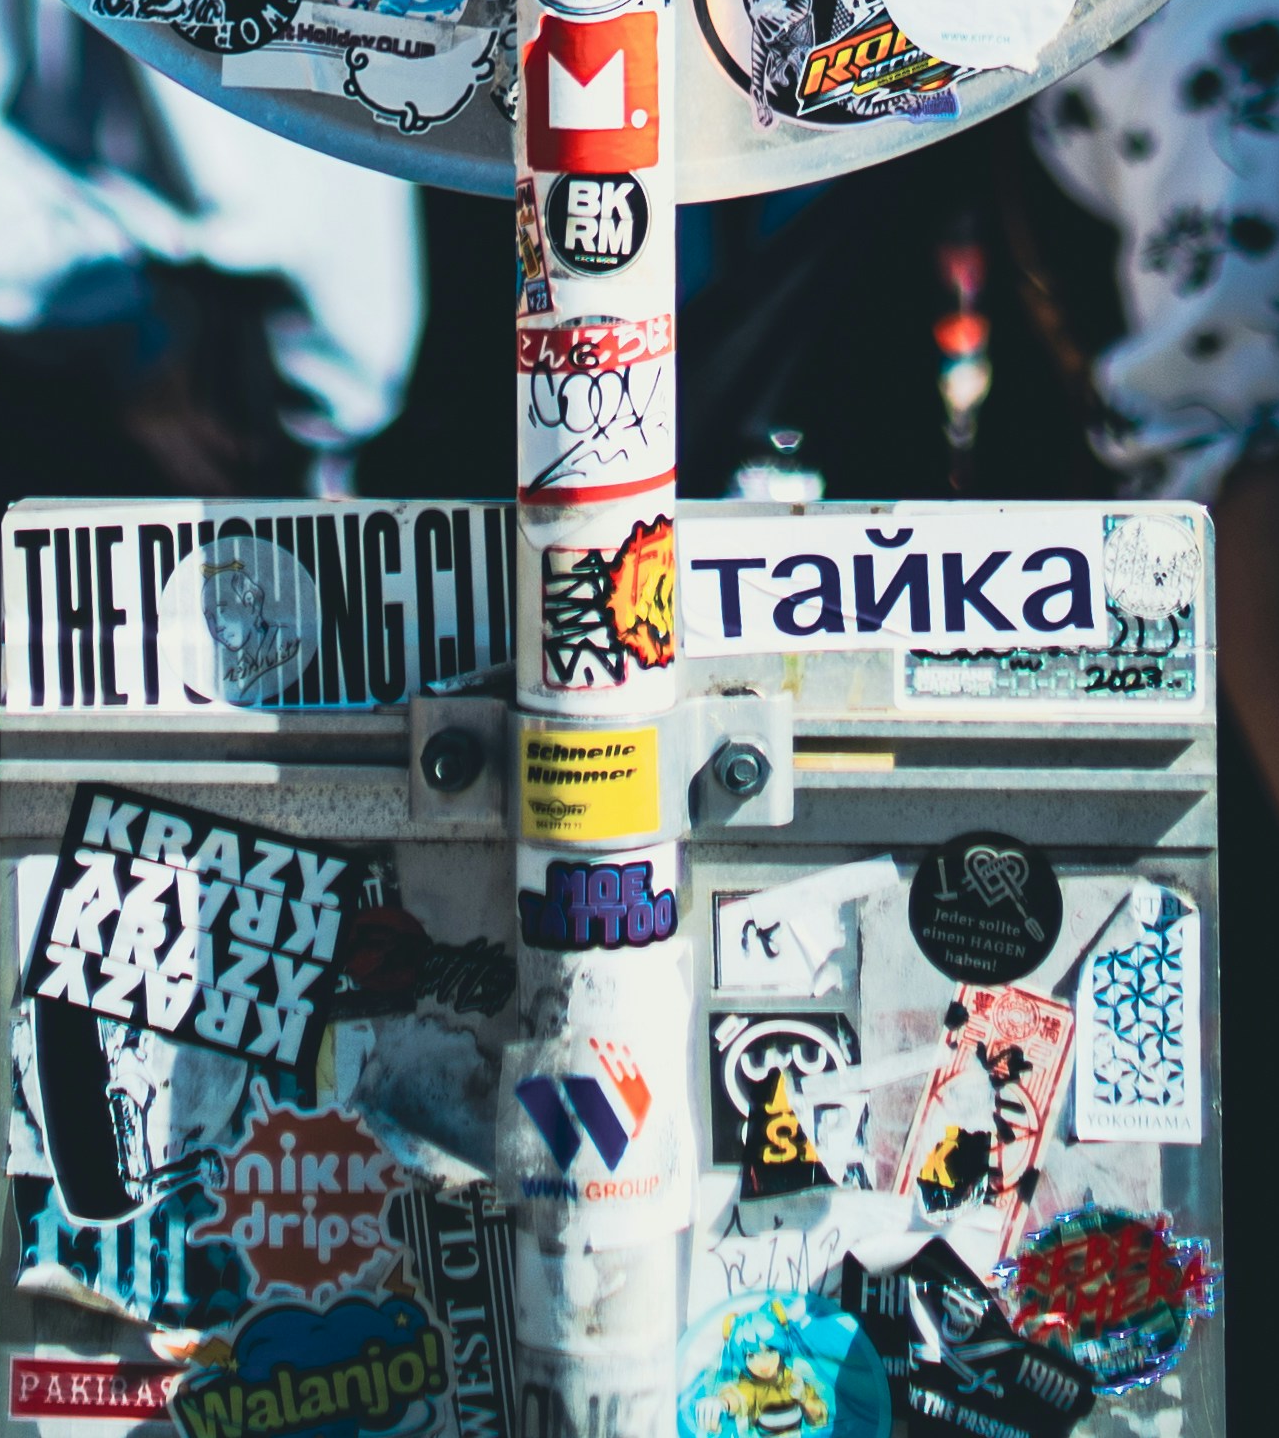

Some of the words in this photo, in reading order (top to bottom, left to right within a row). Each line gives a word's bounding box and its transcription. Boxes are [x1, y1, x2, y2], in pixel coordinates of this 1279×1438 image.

[567, 180, 635, 220] BK
[564, 217, 633, 256] RM
[690, 527, 1095, 639] тайка
[14, 525, 128, 707] THE
[526, 740, 637, 763] Schnelle
[526, 765, 638, 787] Nummer
[553, 864, 650, 904] MOE
[522, 888, 674, 944] TATTOO
[978, 916, 1021, 936] sollte
[922, 926, 966, 946] einen
[969, 931, 1027, 960] HAGEN
[943, 948, 998, 974] haben!
[1085, 1114, 1193, 1131] YOKOHAMA
[584, 1174, 660, 1204] GROUP
[231, 1195, 383, 1265] drips
[183, 1334, 442, 1438] Walanjo!
